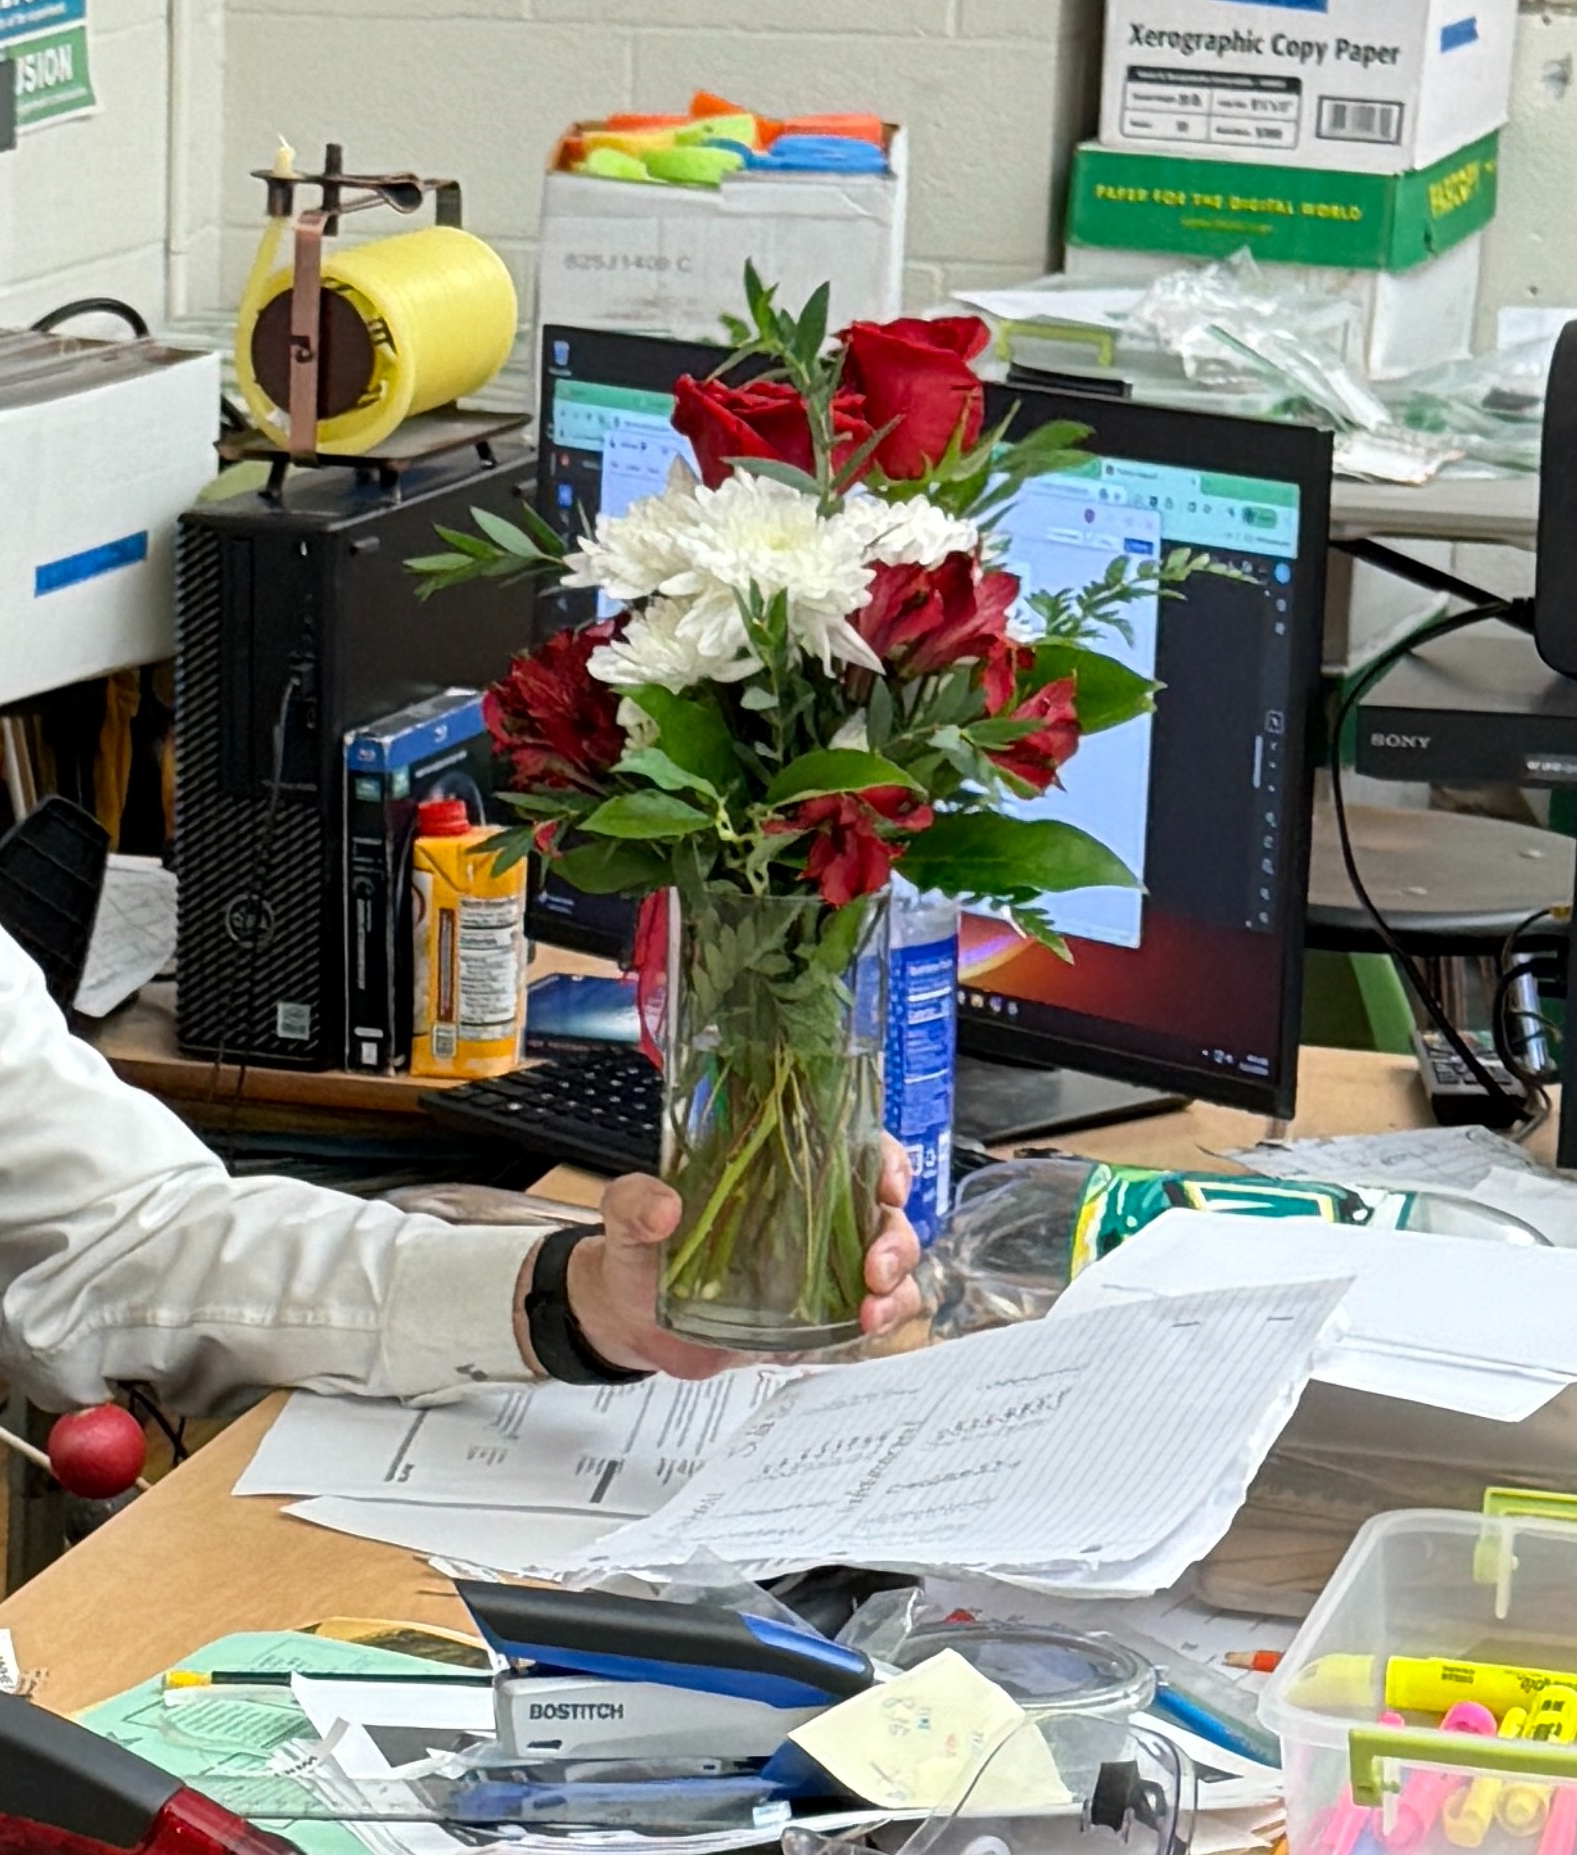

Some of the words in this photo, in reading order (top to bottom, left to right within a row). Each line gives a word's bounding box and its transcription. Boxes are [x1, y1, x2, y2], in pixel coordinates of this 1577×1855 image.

[1127, 23, 1264, 56] Xerographic
[1271, 34, 1329, 65] Copy
[1335, 38, 1401, 69] Paper
[1095, 183, 1148, 202] PAPER
[1191, 193, 1223, 209] THE
[1228, 195, 1295, 216] DIGITAL
[1300, 202, 1363, 223] WORLD
[1370, 732, 1431, 749] SONY
[529, 1702, 625, 1720] BOSTITCH
